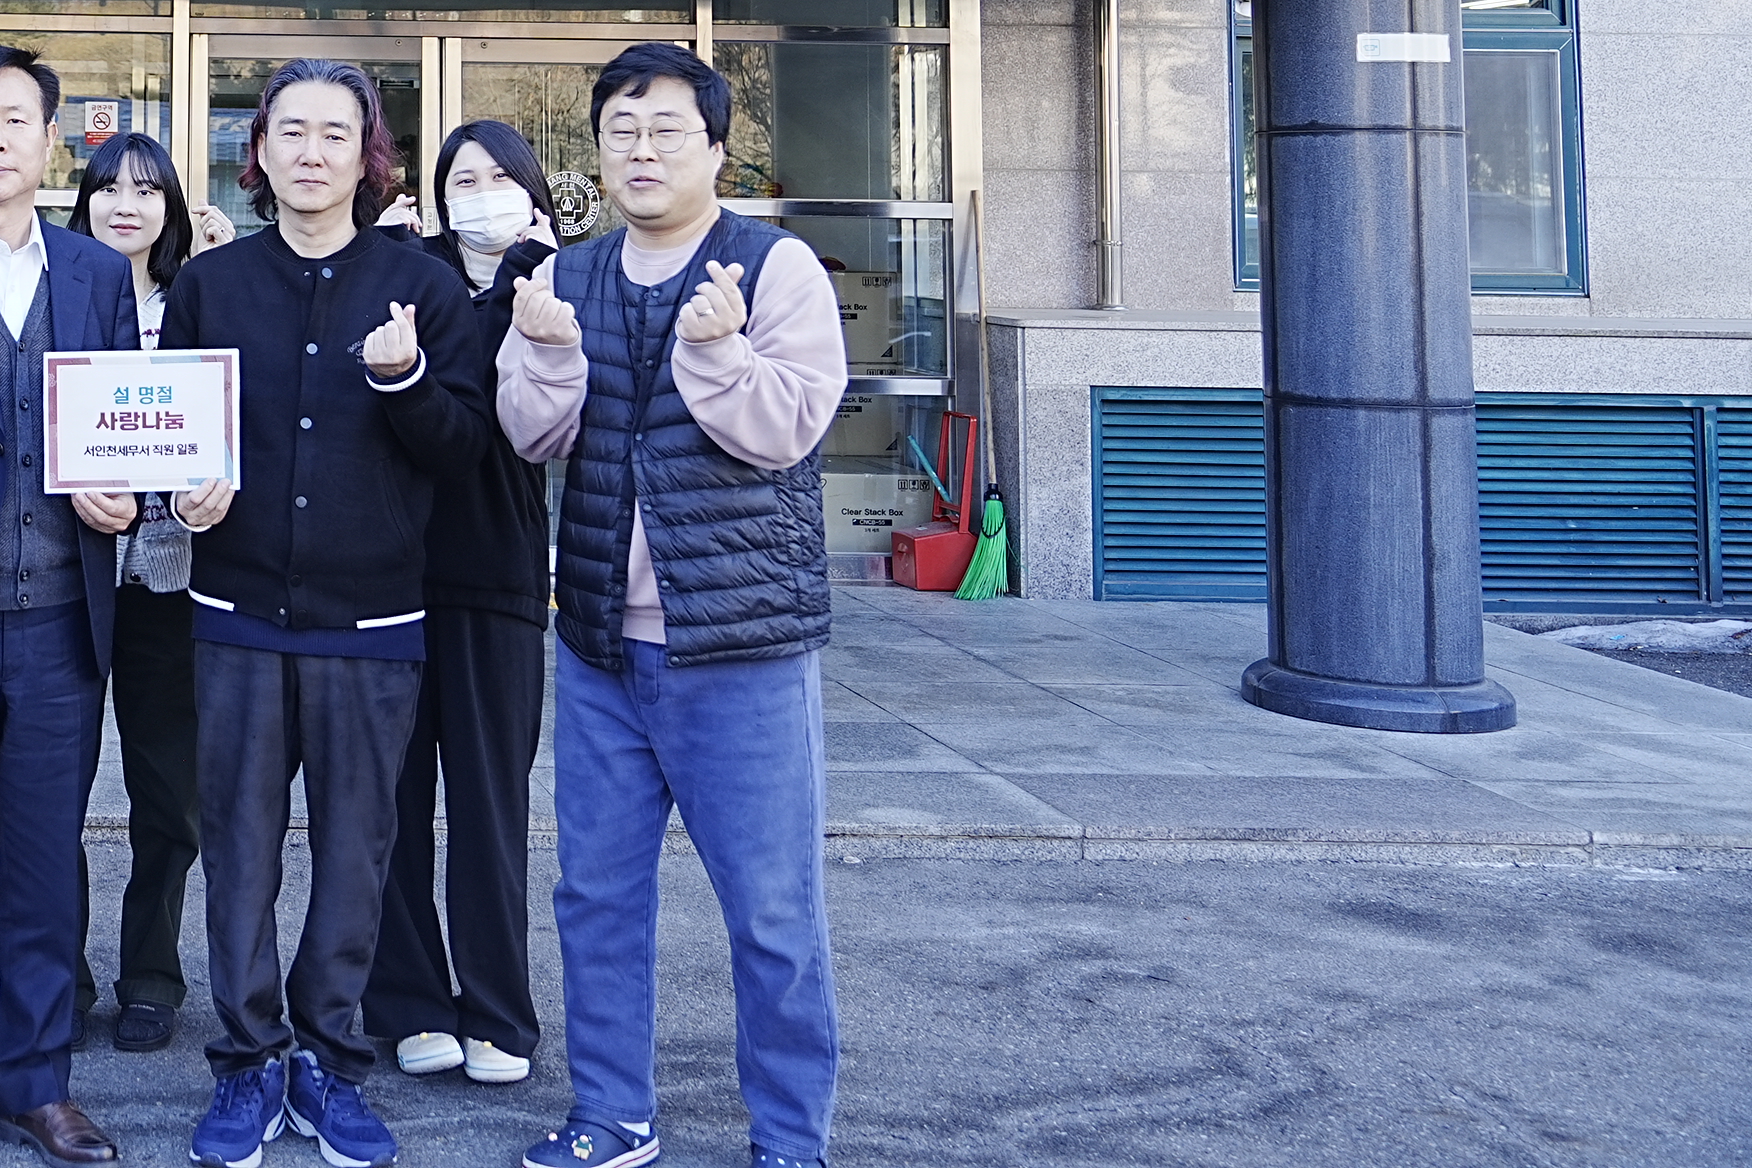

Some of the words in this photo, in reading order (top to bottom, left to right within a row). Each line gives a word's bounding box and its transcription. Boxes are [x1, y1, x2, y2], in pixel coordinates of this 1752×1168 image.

[854, 303, 868, 311] Box
[113, 386, 130, 405] 설
[138, 385, 173, 405] 명절
[858, 396, 873, 404] Box
[95, 410, 185, 431] 사랑나눔
[84, 444, 150, 457] 서인천세무서
[152, 443, 174, 456] 직원
[176, 442, 199, 456] 일동
[841, 507, 862, 516] Clear
[864, 508, 887, 516] Stack
[889, 508, 904, 517] Box
